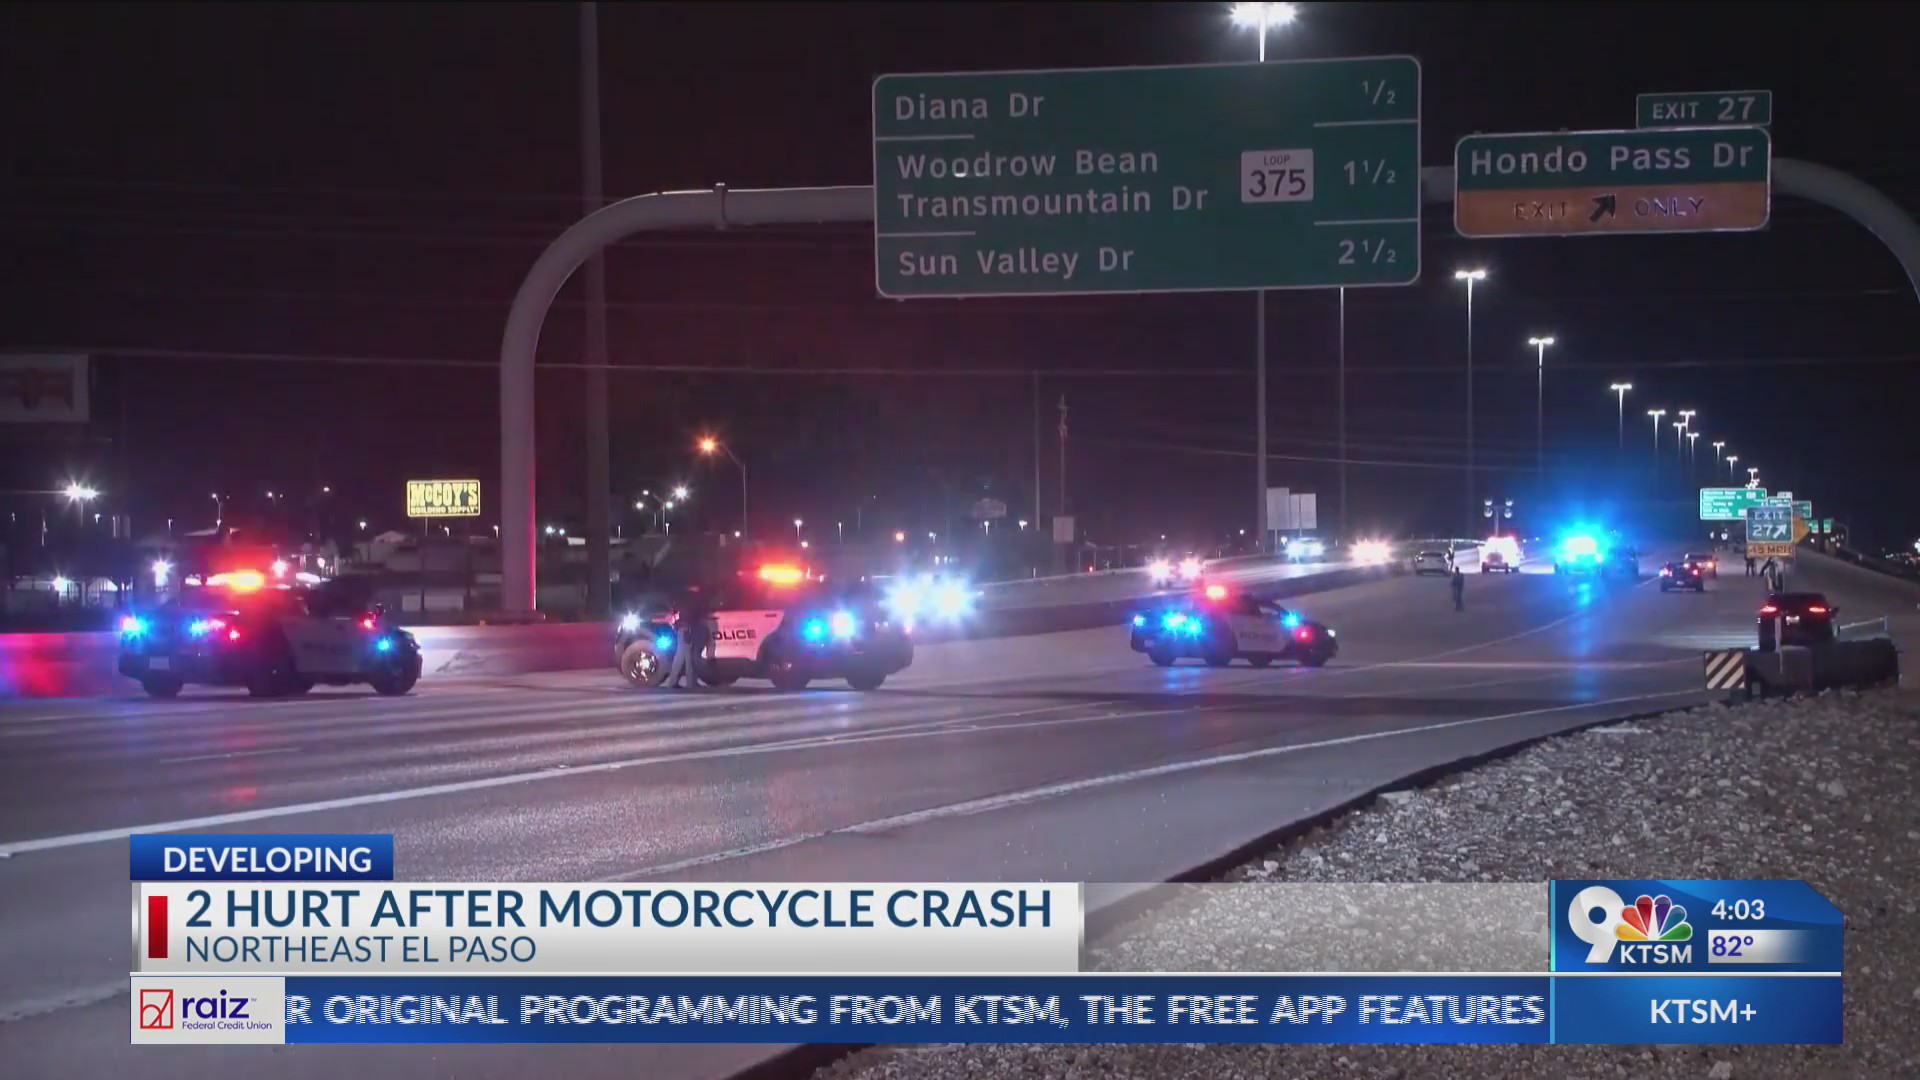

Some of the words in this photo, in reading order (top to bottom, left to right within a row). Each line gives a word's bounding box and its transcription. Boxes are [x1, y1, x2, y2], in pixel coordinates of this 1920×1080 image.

[895, 94, 987, 120] Diana
[1009, 91, 1043, 117] Dr
[1653, 102, 1699, 119] EXIT
[1718, 97, 1755, 120] 27
[897, 150, 1056, 179] Woodrow
[1076, 147, 1158, 174] Bean
[1263, 154, 1291, 166] LOOP
[1471, 146, 1587, 175] Hondo
[1611, 145, 1690, 170] Pass
[1713, 142, 1752, 167] Dr
[1249, 168, 1307, 198] 375
[898, 188, 1151, 217] Transmountain
[1173, 184, 1208, 210] Dr
[1513, 202, 1567, 220] EXIT
[1635, 197, 1704, 217] ONLY
[899, 250, 958, 275] Sun
[976, 247, 1079, 278] Valley
[1099, 246, 1134, 271] Dr
[1754, 511, 1784, 521] EXIT
[1752, 524, 1773, 537] 27
[1749, 545, 1765, 554] 45
[713, 629, 757, 640] OLICE
